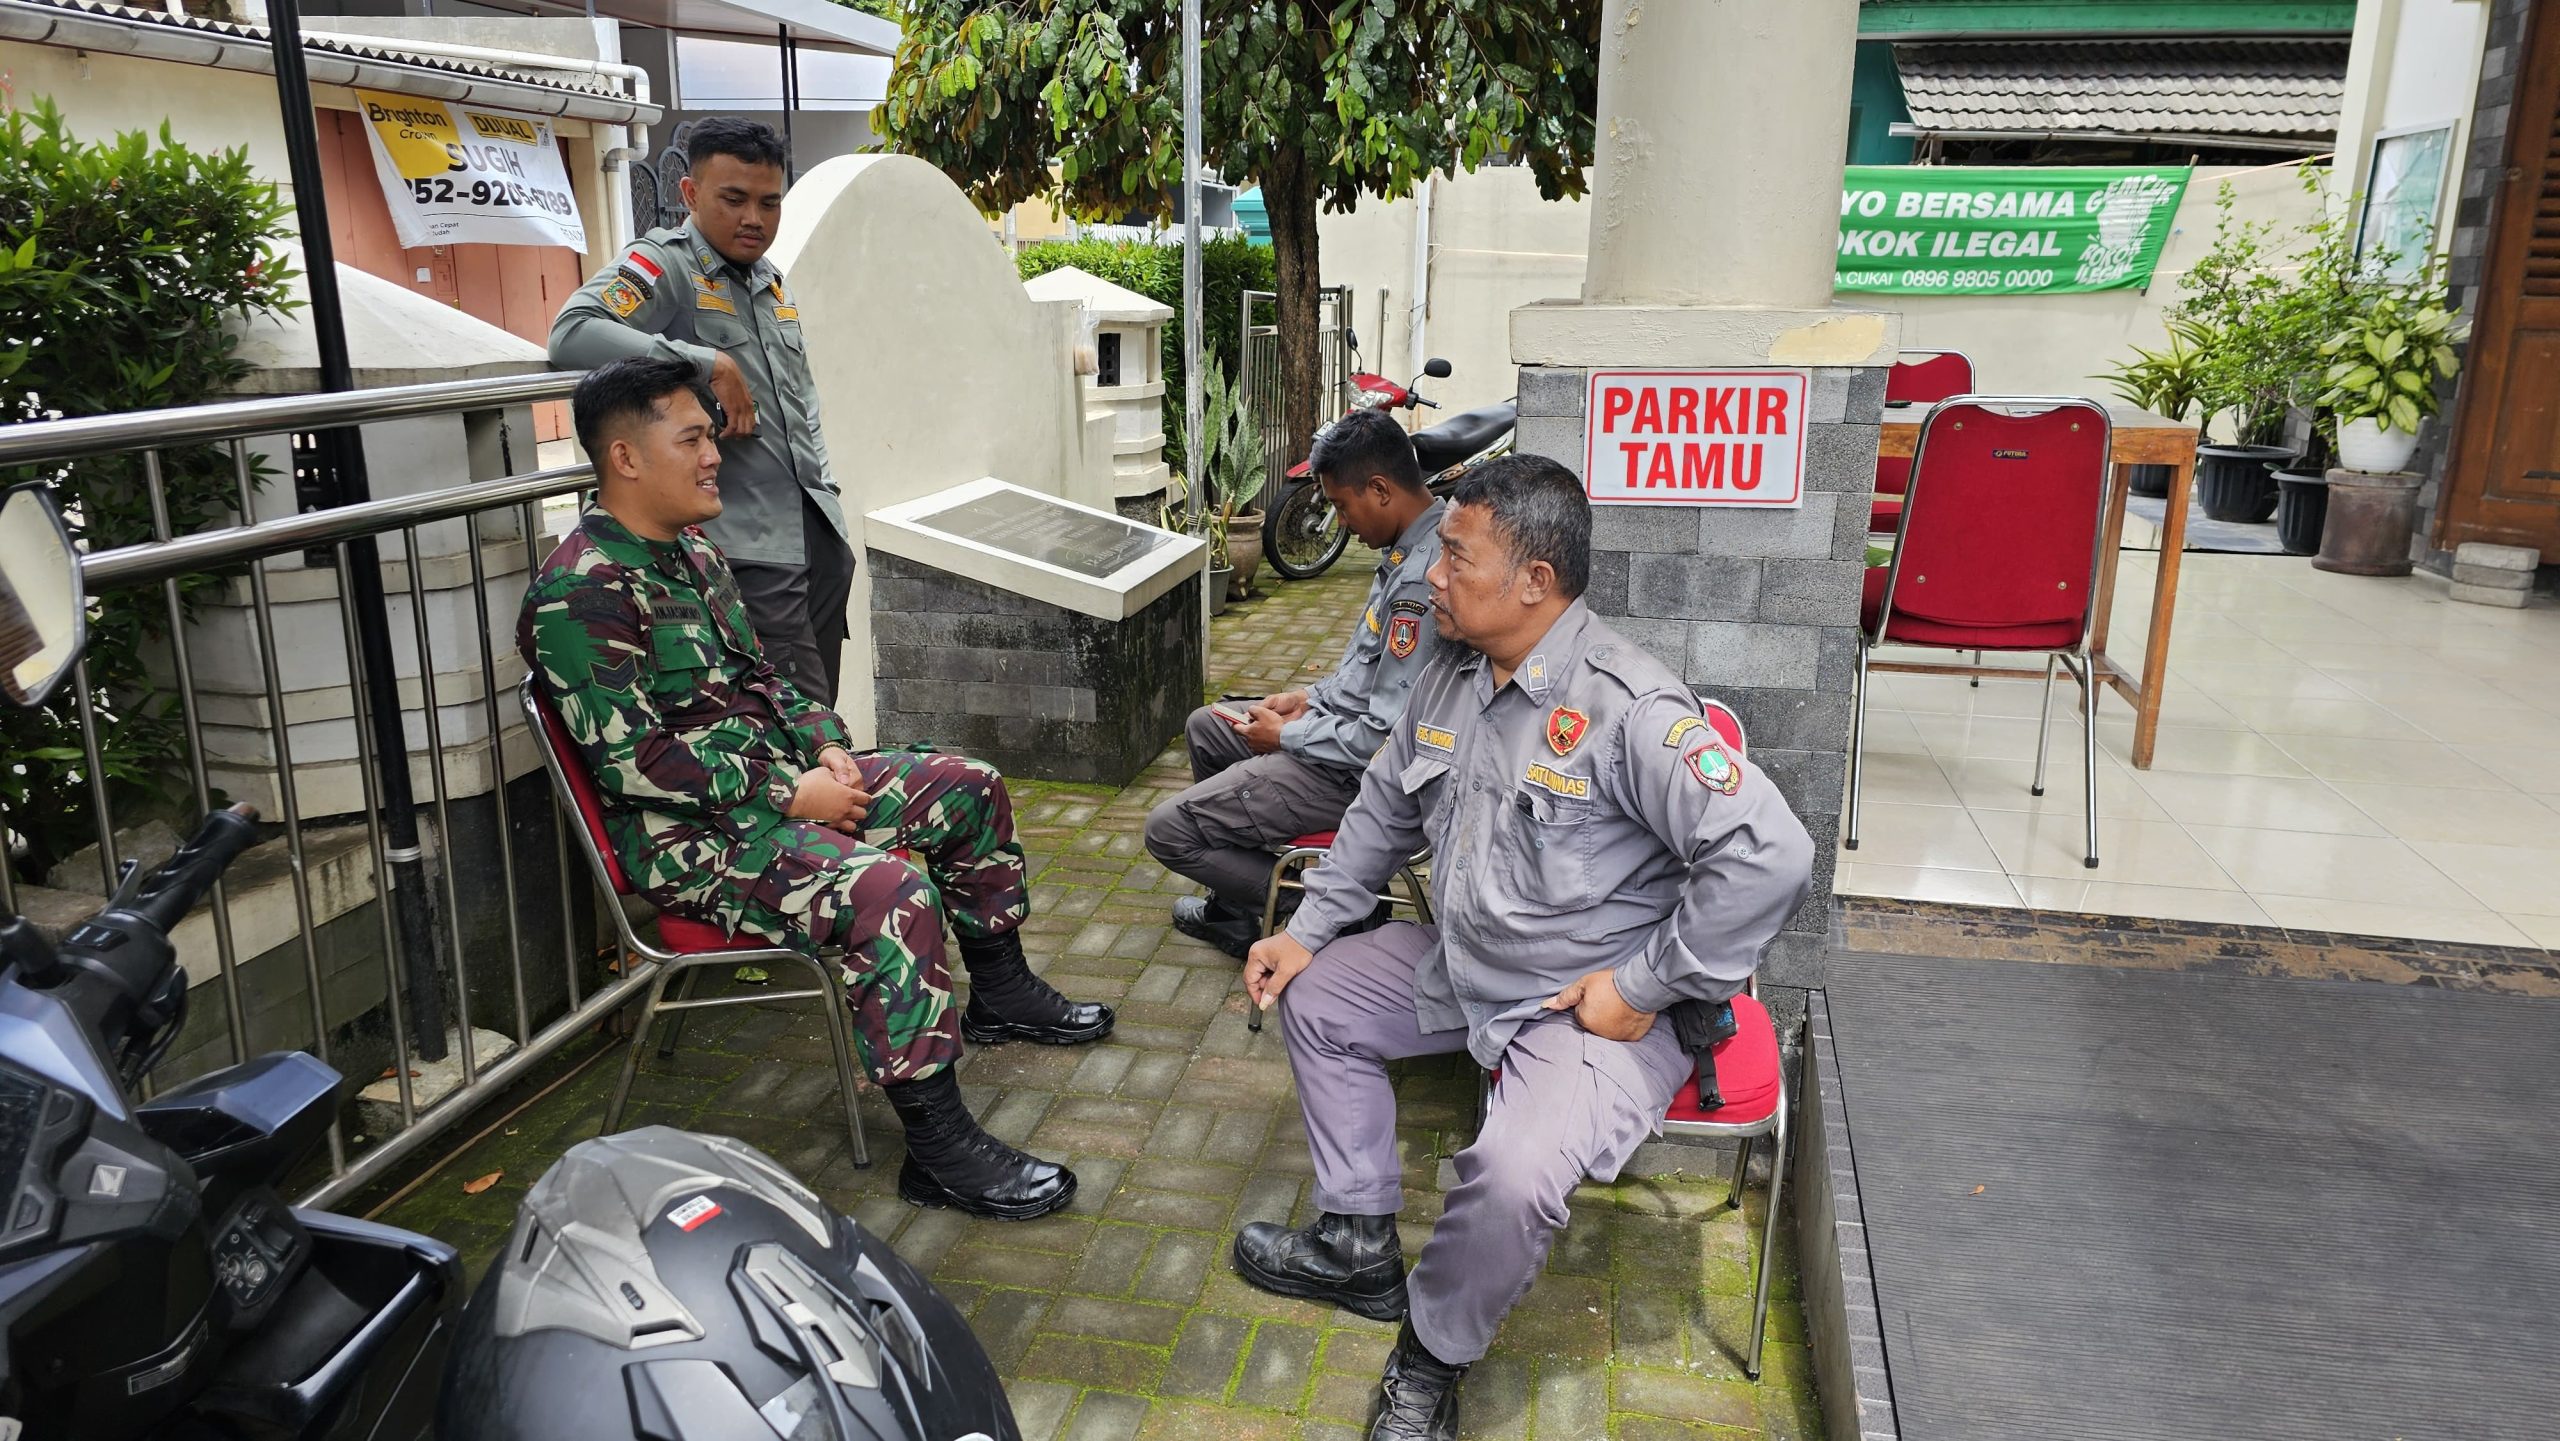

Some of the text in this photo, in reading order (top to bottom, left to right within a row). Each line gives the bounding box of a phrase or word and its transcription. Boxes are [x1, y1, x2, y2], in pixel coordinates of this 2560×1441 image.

[367, 102, 447, 128] Brighton
[471, 115, 533, 139] DIJUAL
[400, 129, 437, 140] Crown
[446, 143, 526, 178] SUGIH
[1895, 190, 2075, 219] BERSAMA
[1930, 230, 2063, 257] ILEGAL
[1846, 270, 1893, 286] CUKAI
[1902, 270, 1948, 287] 0896
[1952, 270, 1999, 288] 9805
[2003, 269, 2053, 288] 0000
[1602, 387, 1789, 435] PARKIR
[1619, 442, 1763, 490] TAMU
